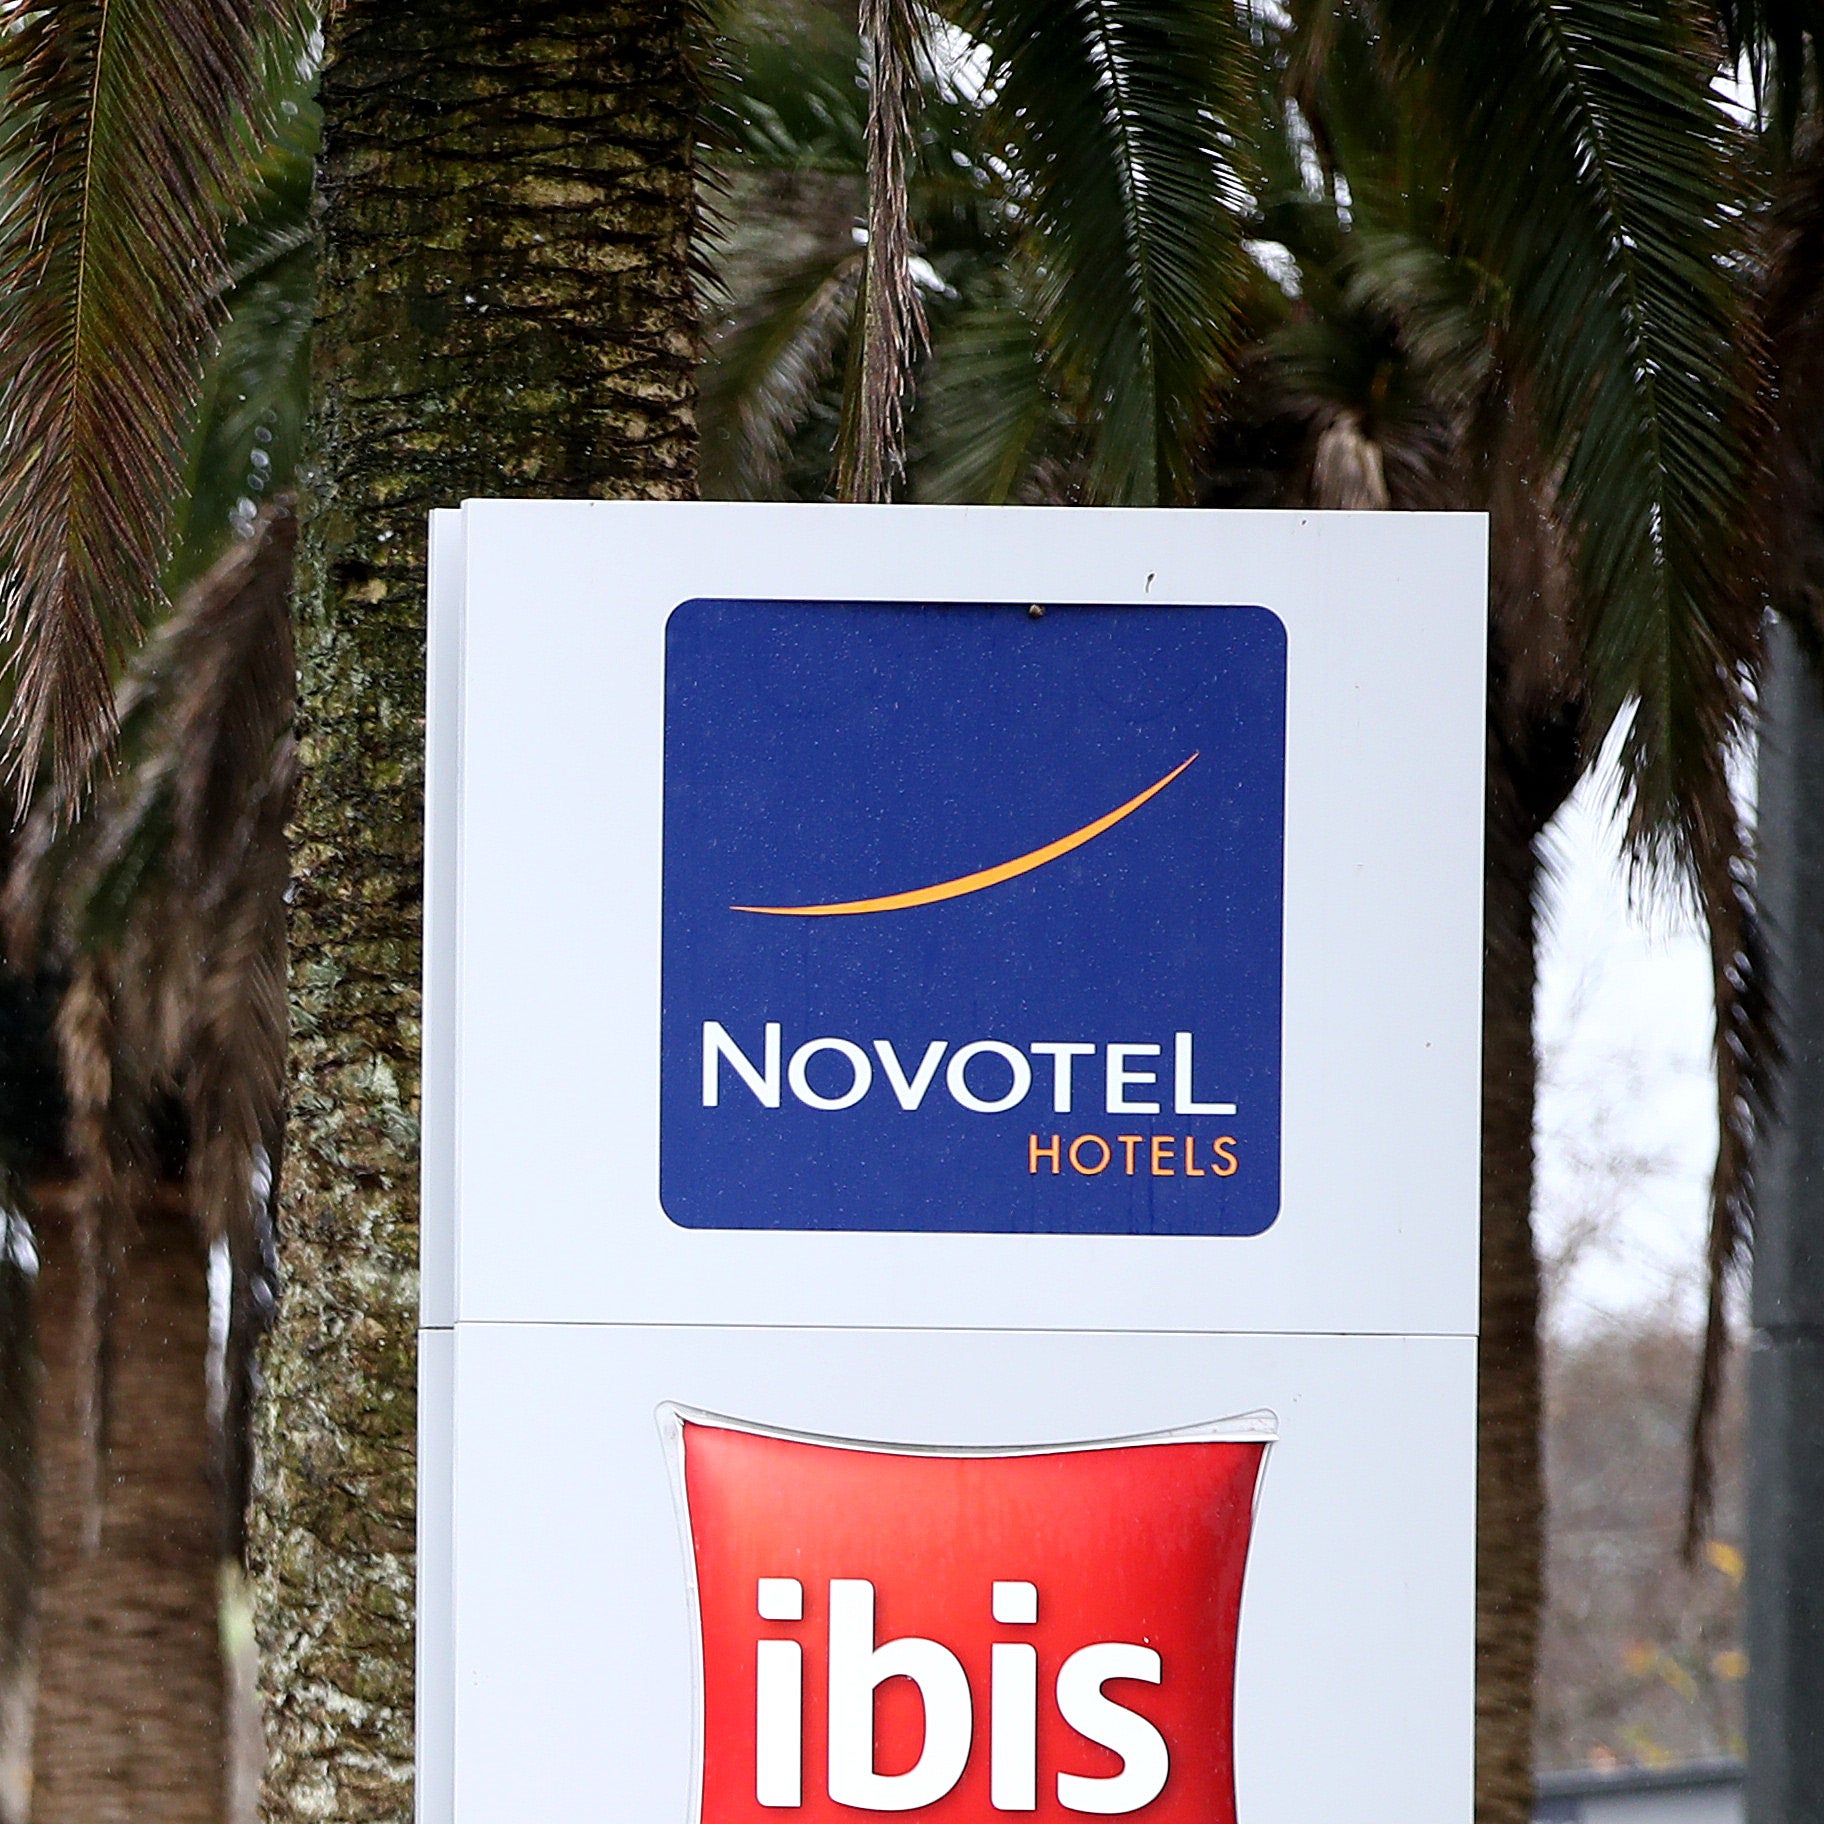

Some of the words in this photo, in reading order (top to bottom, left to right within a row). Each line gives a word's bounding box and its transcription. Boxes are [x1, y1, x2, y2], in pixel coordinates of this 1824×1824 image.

[702, 1021, 1238, 1115] NOVOTEL
[1028, 1133, 1240, 1177] HOTELS
[755, 1578, 1170, 1814] ibis
